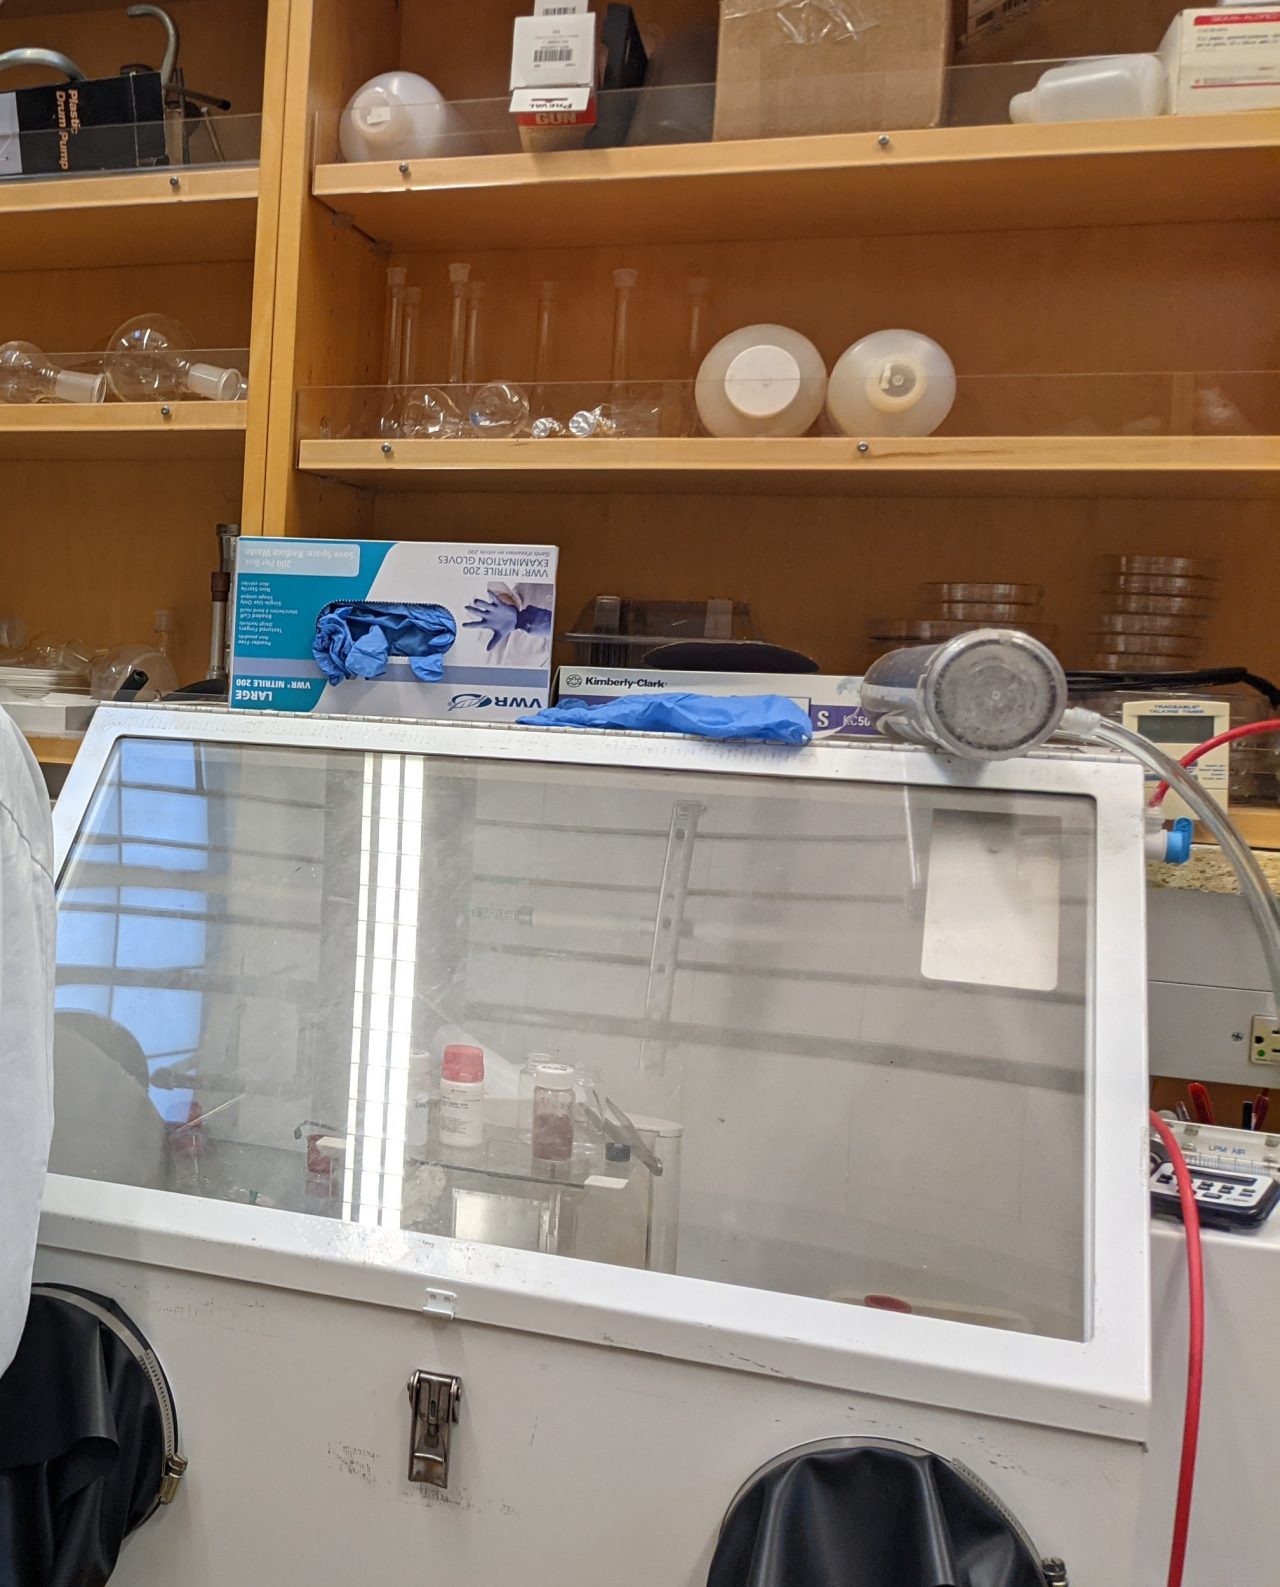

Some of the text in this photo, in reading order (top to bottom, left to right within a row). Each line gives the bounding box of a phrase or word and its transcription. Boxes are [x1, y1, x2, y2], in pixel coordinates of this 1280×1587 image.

[68, 89, 80, 134] Plastic
[536, 112, 576, 124] GUN
[56, 90, 68, 170] Drum Pump
[438, 556, 549, 567] EXAMINATION GLOVES
[463, 566, 480, 575] 200
[484, 567, 519, 576] NITRILE
[253, 680, 285, 688] NITRILE
[235, 690, 273, 701] LARGE
[817, 711, 829, 728] S
